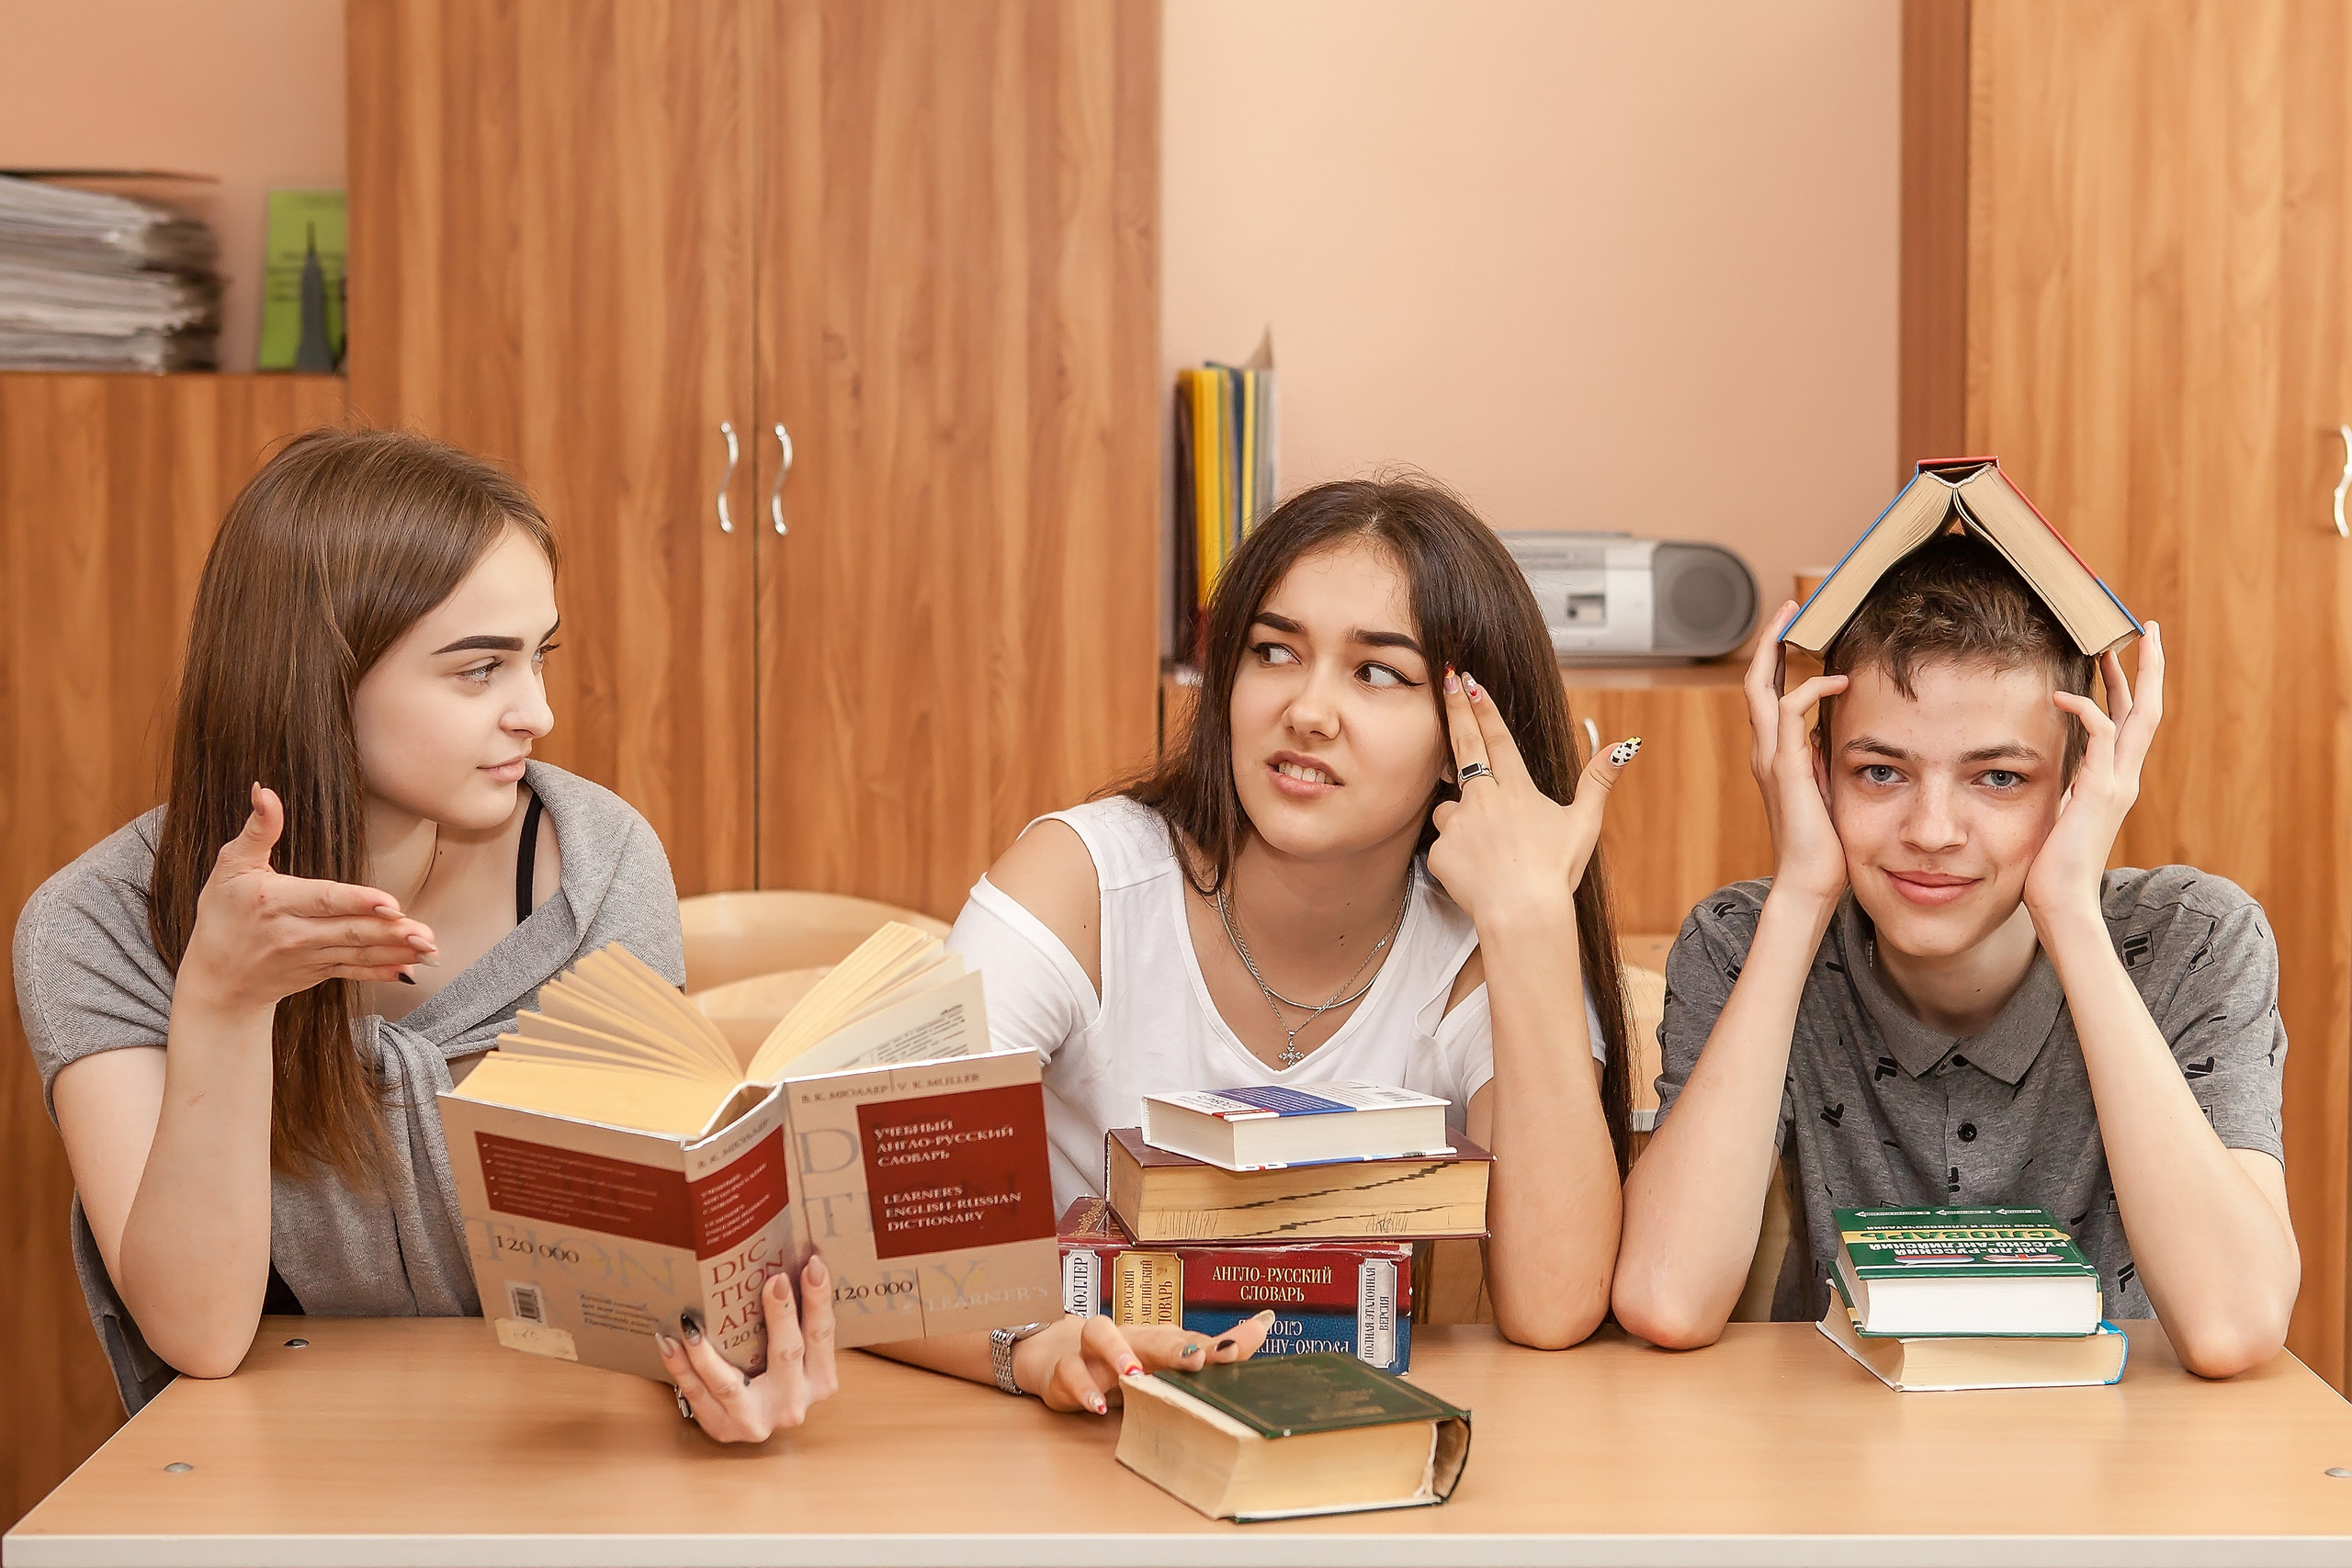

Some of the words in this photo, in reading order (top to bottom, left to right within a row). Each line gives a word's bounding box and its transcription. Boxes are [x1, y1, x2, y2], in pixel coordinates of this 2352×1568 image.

[874, 1118, 953, 1141] УЧЕБНЫЙ
[876, 1125, 1014, 1154] АНГЛО-РУССКИЙ
[877, 1150, 950, 1168] СЛОВАРЬ
[884, 1185, 964, 1205] LEARNER'S
[886, 1191, 1022, 1218] ENGLISH-RUSSIAN
[888, 1211, 985, 1233] DICTIONARY
[1860, 1229, 2055, 1241] СЛОВАРЬ
[1869, 1240, 2068, 1251] РУССКО-АНГЛИЙСКИЙ
[494, 1235, 534, 1255] 120
[538, 1244, 581, 1265] 000
[710, 1237, 769, 1286] DIC
[1894, 1245, 2048, 1256] АНГЛО-РУССКИЙ
[1212, 1266, 1332, 1284] АНГЛО-РУССКИЙ
[833, 1285, 869, 1303] 120
[875, 1280, 913, 1297] 000
[1158, 1280, 1173, 1325] ЛОВАРЬ
[1240, 1285, 1305, 1303] СЛОВАРЬ
[1364, 1267, 1376, 1321] ЭТАЛОННАЯ
[717, 1300, 763, 1337] AR
[1379, 1296, 1390, 1331] ВЕРСИЯ
[1363, 1322, 1375, 1359] ПОЛНАЯ
